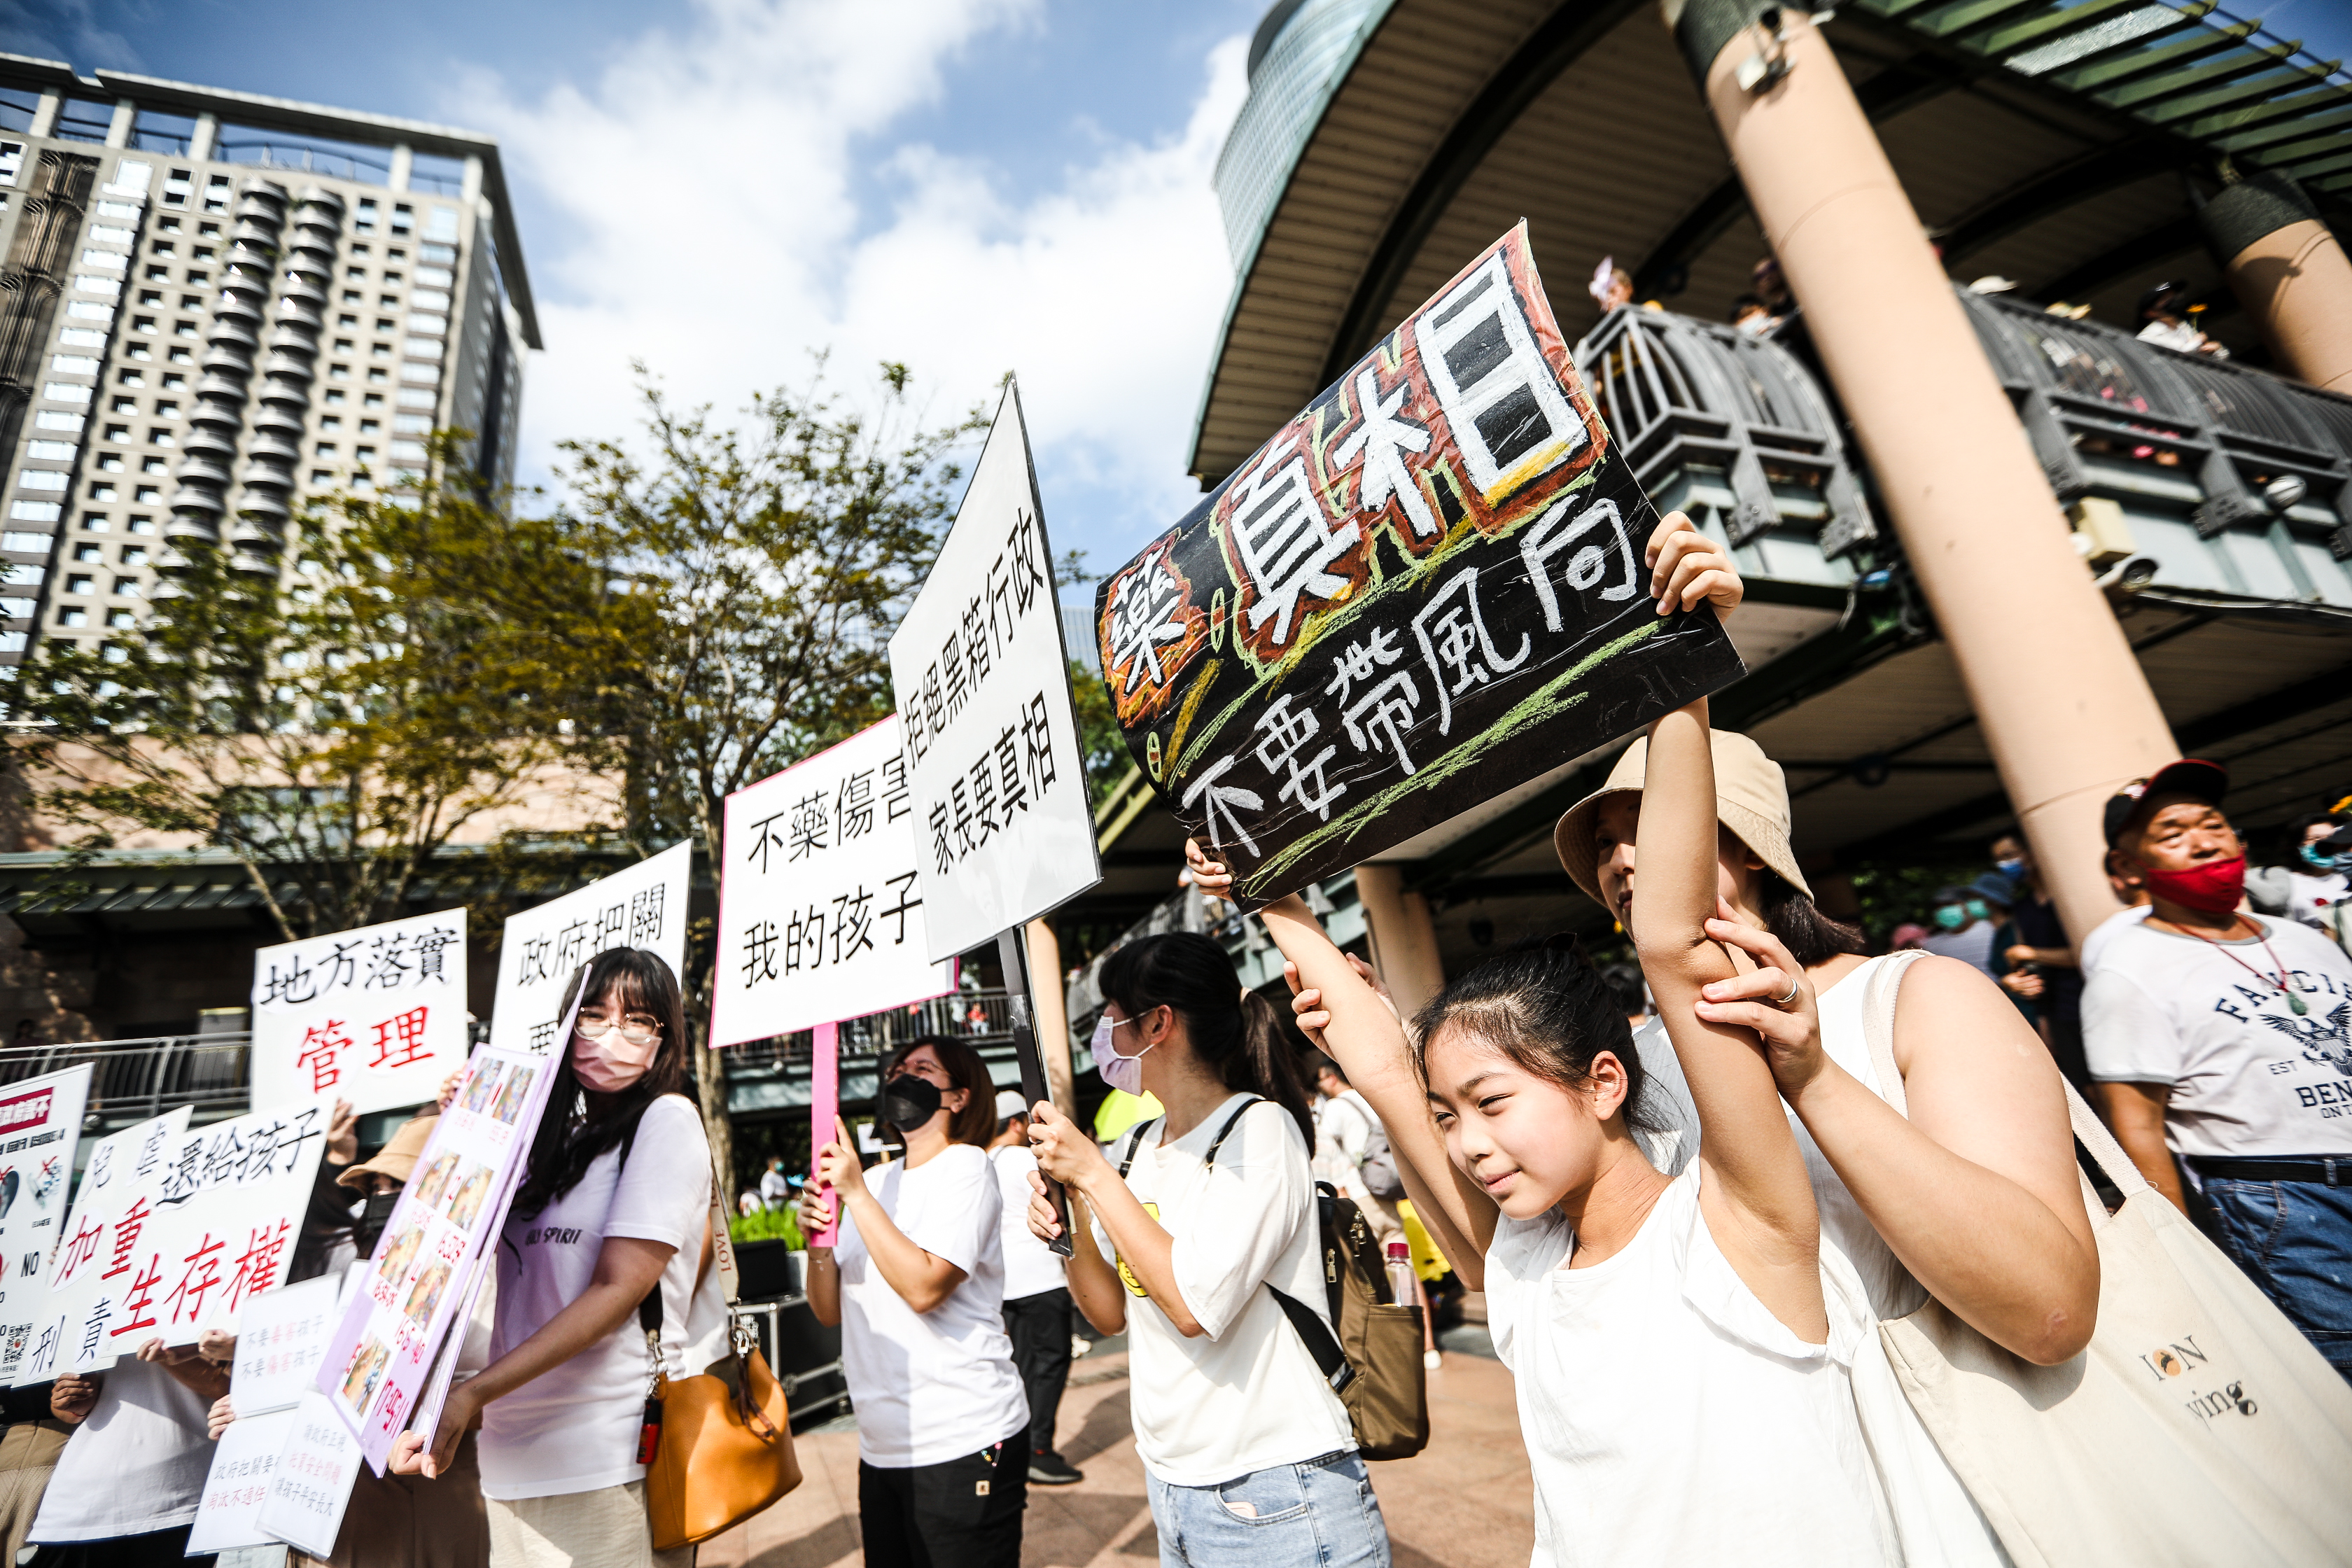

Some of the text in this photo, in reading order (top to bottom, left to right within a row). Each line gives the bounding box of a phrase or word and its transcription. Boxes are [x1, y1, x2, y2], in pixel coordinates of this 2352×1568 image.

[903, 506, 1044, 771] 拒絕黑箱行政
[1182, 493, 1637, 858] 不要帶風向
[928, 690, 1058, 876] 家長要真相
[258, 925, 460, 1006] 地方落實
[517, 881, 666, 987] 政府把關
[742, 869, 924, 989] 我的孩子
[297, 1004, 437, 1095] 管理
[2269, 1059, 2298, 1075] EST
[155, 1107, 323, 1209] 還給孩子
[20, 1251, 40, 1278] NO
[110, 1217, 292, 1338] 生存權
[715, 1228, 732, 1272] LOVE
